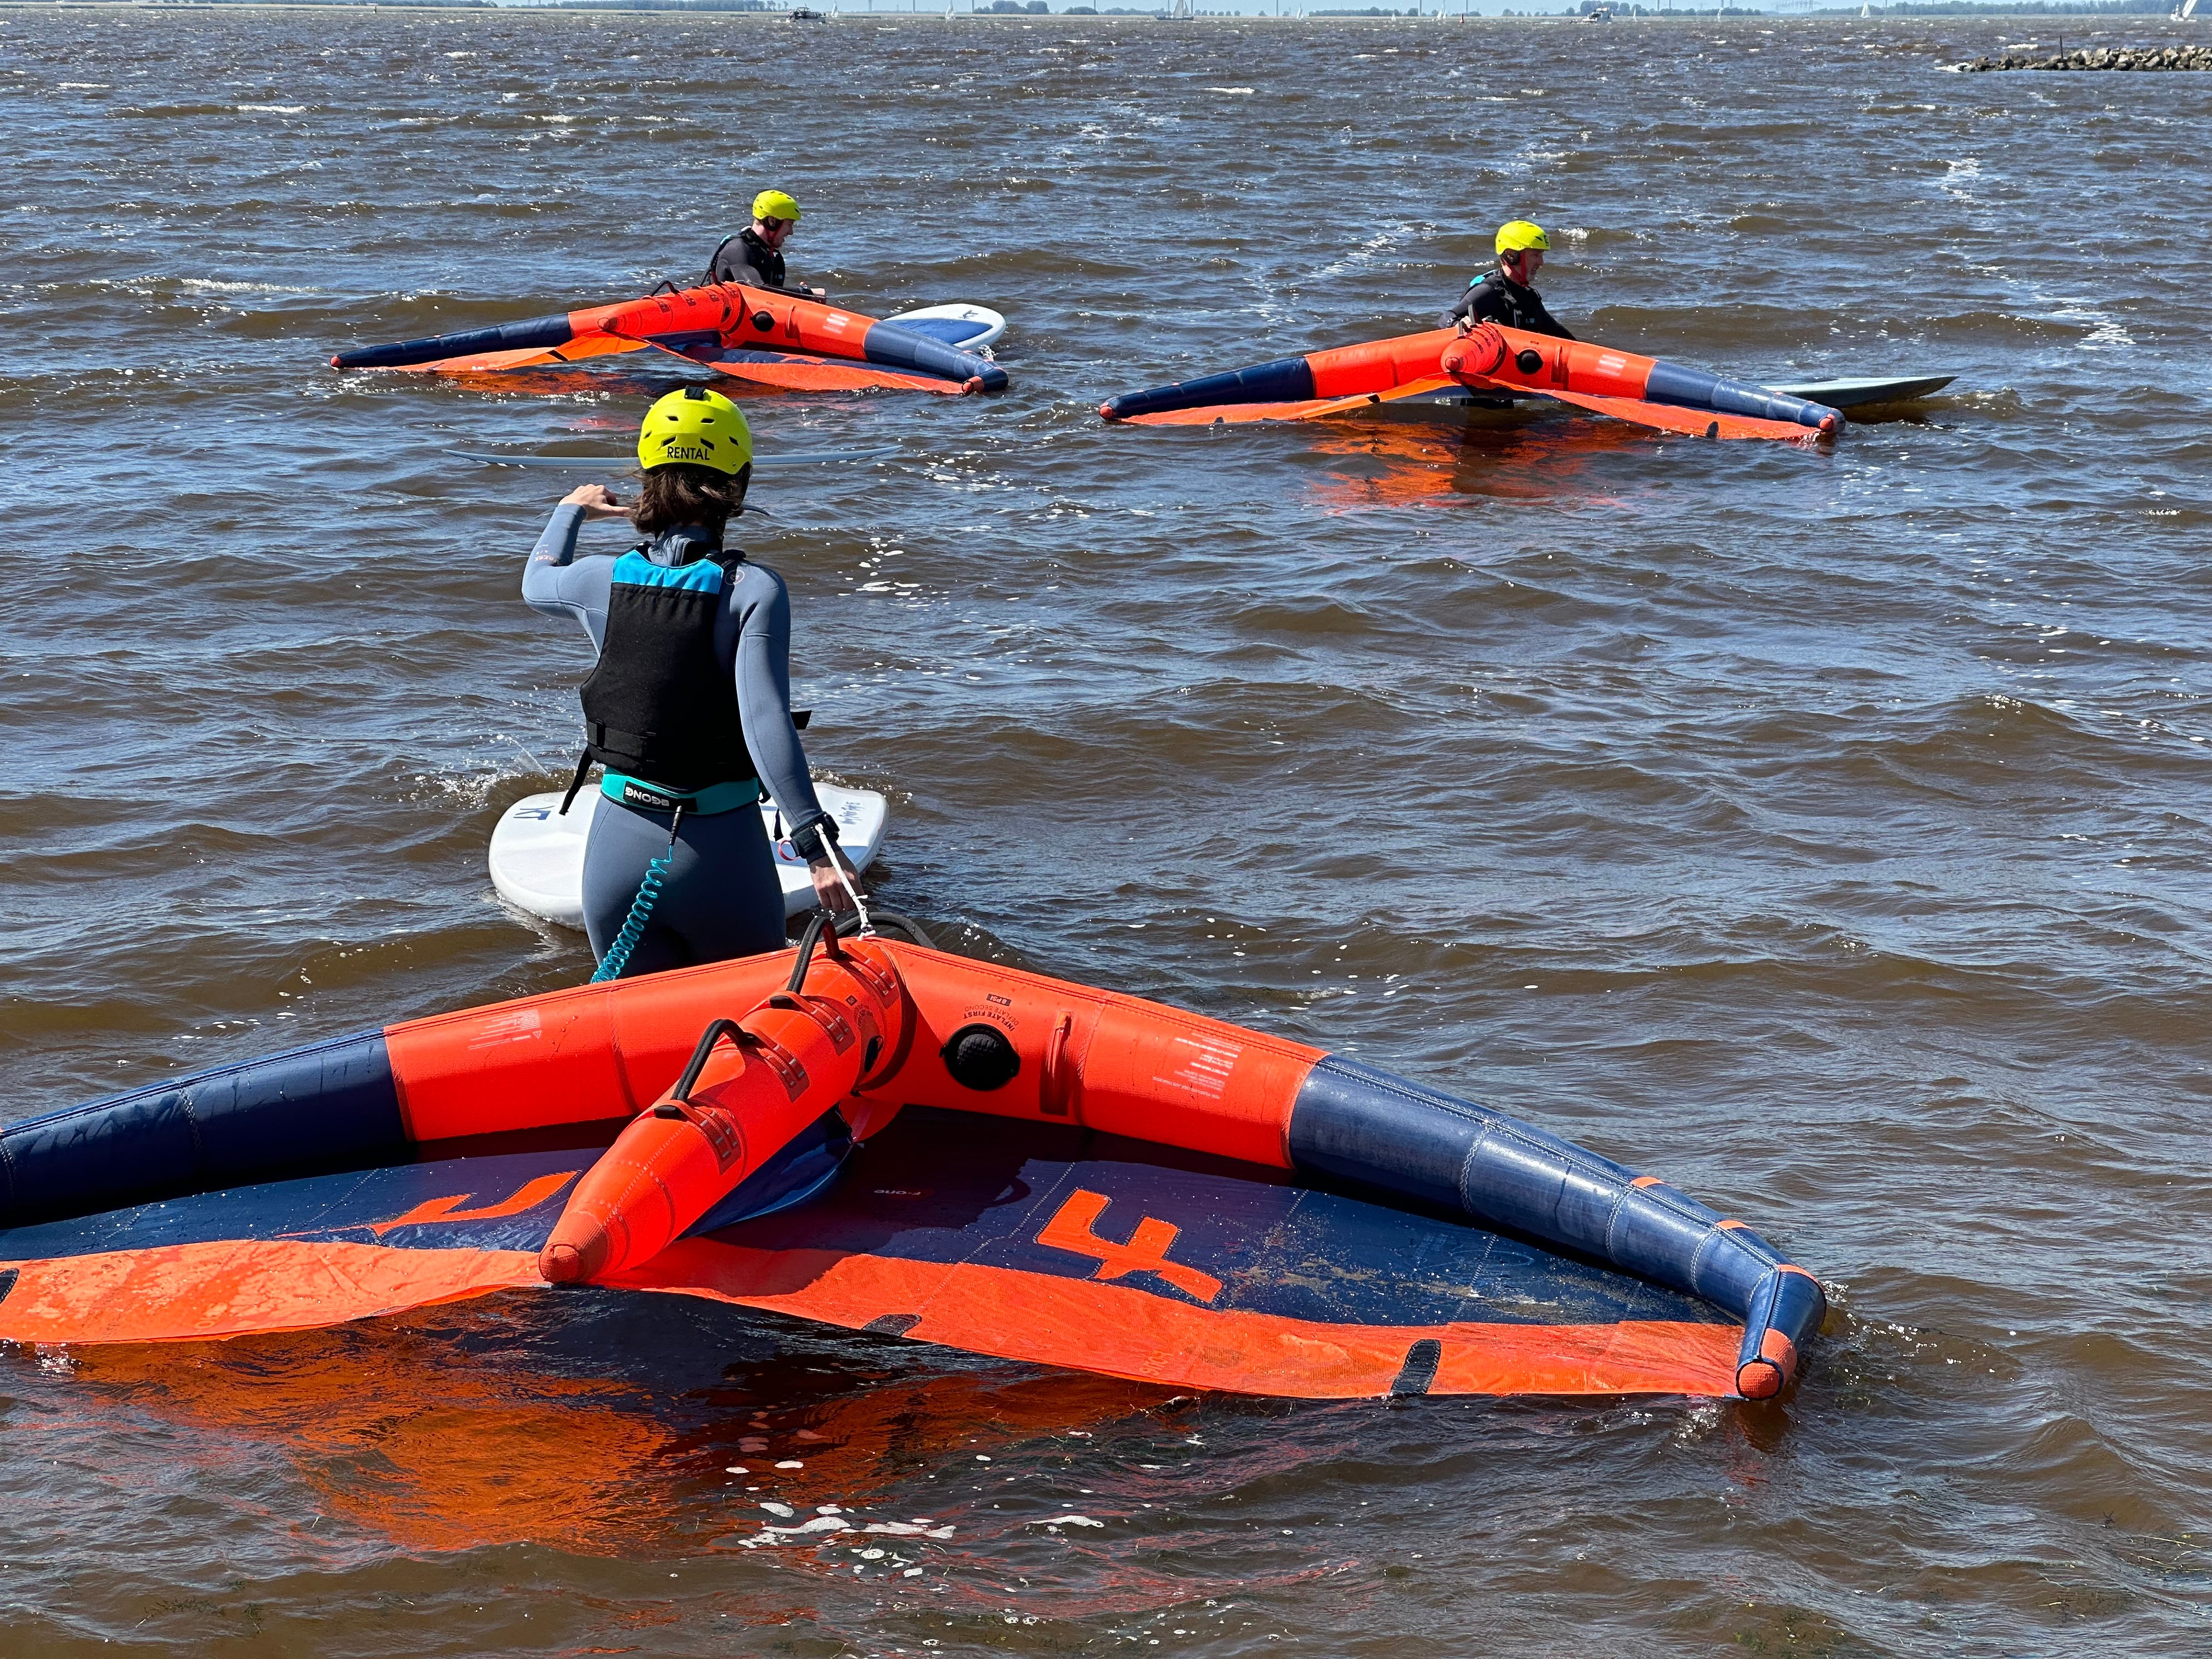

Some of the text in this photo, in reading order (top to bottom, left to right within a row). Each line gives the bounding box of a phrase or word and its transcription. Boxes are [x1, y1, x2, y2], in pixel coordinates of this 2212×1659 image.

[667, 446, 710, 460] RENTAL
[625, 787, 661, 804] GONG
[963, 1011, 1015, 1032] INFLATE FIRST
